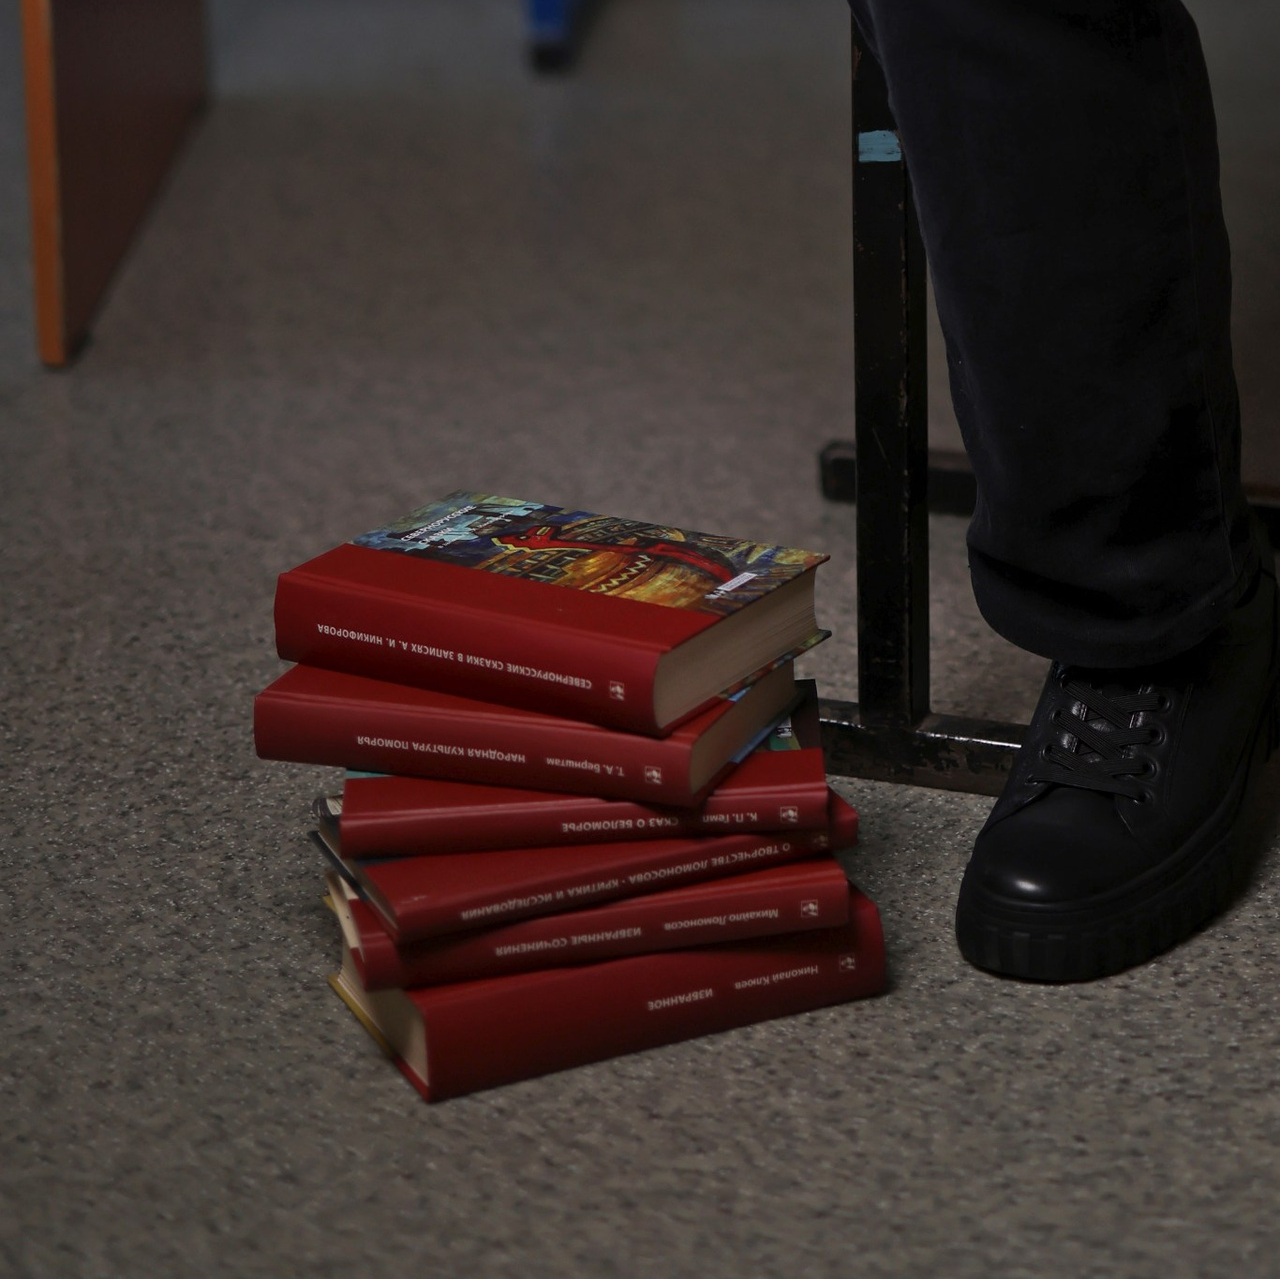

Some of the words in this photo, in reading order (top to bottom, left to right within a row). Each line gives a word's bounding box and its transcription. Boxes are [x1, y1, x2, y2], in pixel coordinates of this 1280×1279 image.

[317, 623, 383, 645] НИКИФОРОВА
[411, 643, 454, 660] ЗАПИСЯХ
[466, 655, 504, 671] СКАЗКИ
[506, 663, 592, 690] СЕВЕРНОРУССКИЕ
[357, 736, 409, 749] ПОМОРЬЯ
[412, 742, 464, 756] КУЛЬТУРА
[468, 748, 525, 763] НАРОДНАЯ
[546, 757, 600, 773] Бернштам
[562, 820, 632, 832] БЕЛОМОРЬЕ
[649, 817, 679, 827] СКАЗ
[711, 844, 779, 867] ТВОРЧЕСТВЕ
[628, 860, 708, 885] ЛОМОНОСОВА
[567, 879, 618, 897] КРИТИКА
[461, 892, 553, 921] ИССЛЕДОВАНИЯ
[664, 915, 727, 932] Ломоносов
[729, 908, 779, 924] Михайло
[571, 927, 641, 945] ИЗБРАННЫЕ
[495, 937, 567, 956] СОЧИНЕНИЯ
[773, 965, 818, 982] Николай
[734, 976, 770, 990] Клюев
[647, 988, 713, 1010] ИЗБРАННОЕ
